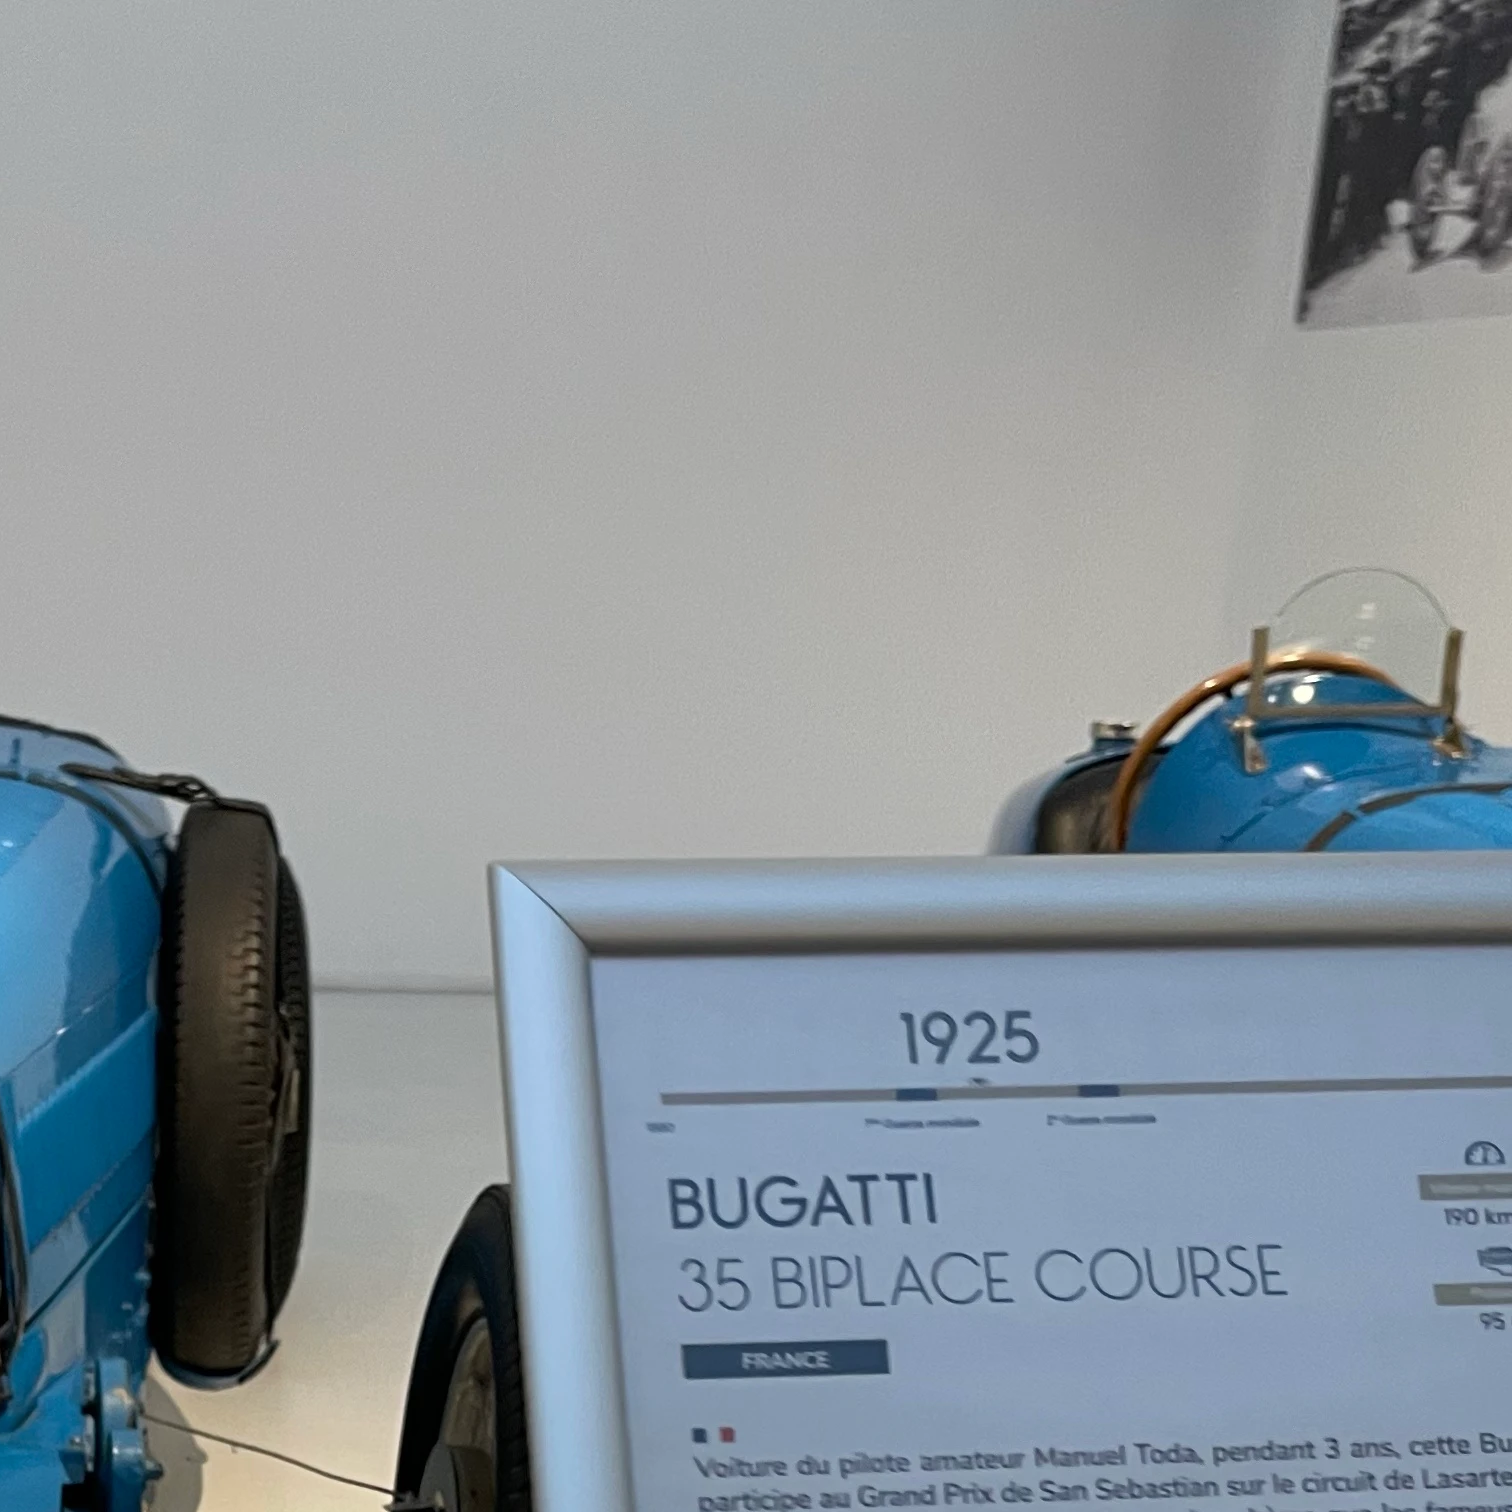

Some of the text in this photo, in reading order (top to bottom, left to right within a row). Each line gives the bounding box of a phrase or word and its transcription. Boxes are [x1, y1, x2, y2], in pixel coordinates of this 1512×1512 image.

[898, 1010, 1041, 1065] 1925
[667, 1173, 939, 1231] BUGATTI
[1445, 1208, 1479, 1225] 190
[678, 1244, 1289, 1313] 35 BIPLACE COURSE
[742, 1351, 830, 1372] FRANCE
[693, 1456, 788, 1478] Voiture
[797, 1455, 830, 1475] du
[840, 1453, 910, 1478] pilote
[920, 1451, 1025, 1471] amateur
[1034, 1444, 1126, 1468] Manuel
[1212, 1440, 1315, 1467] pendant
[1325, 1438, 1340, 1459] 3
[1409, 1436, 1471, 1456] cette
[819, 1492, 851, 1508] au
[857, 1484, 936, 1507] Grand
[943, 1482, 995, 1505] Prix
[1001, 1481, 1033, 1502] de
[1039, 1479, 1087, 1501] San
[1095, 1477, 1219, 1500] Sebastian
[1227, 1479, 1265, 1495] sur
[1272, 1473, 1295, 1494] le
[1301, 1471, 1377, 1493] circuit
[1383, 1469, 1415, 1490] de
